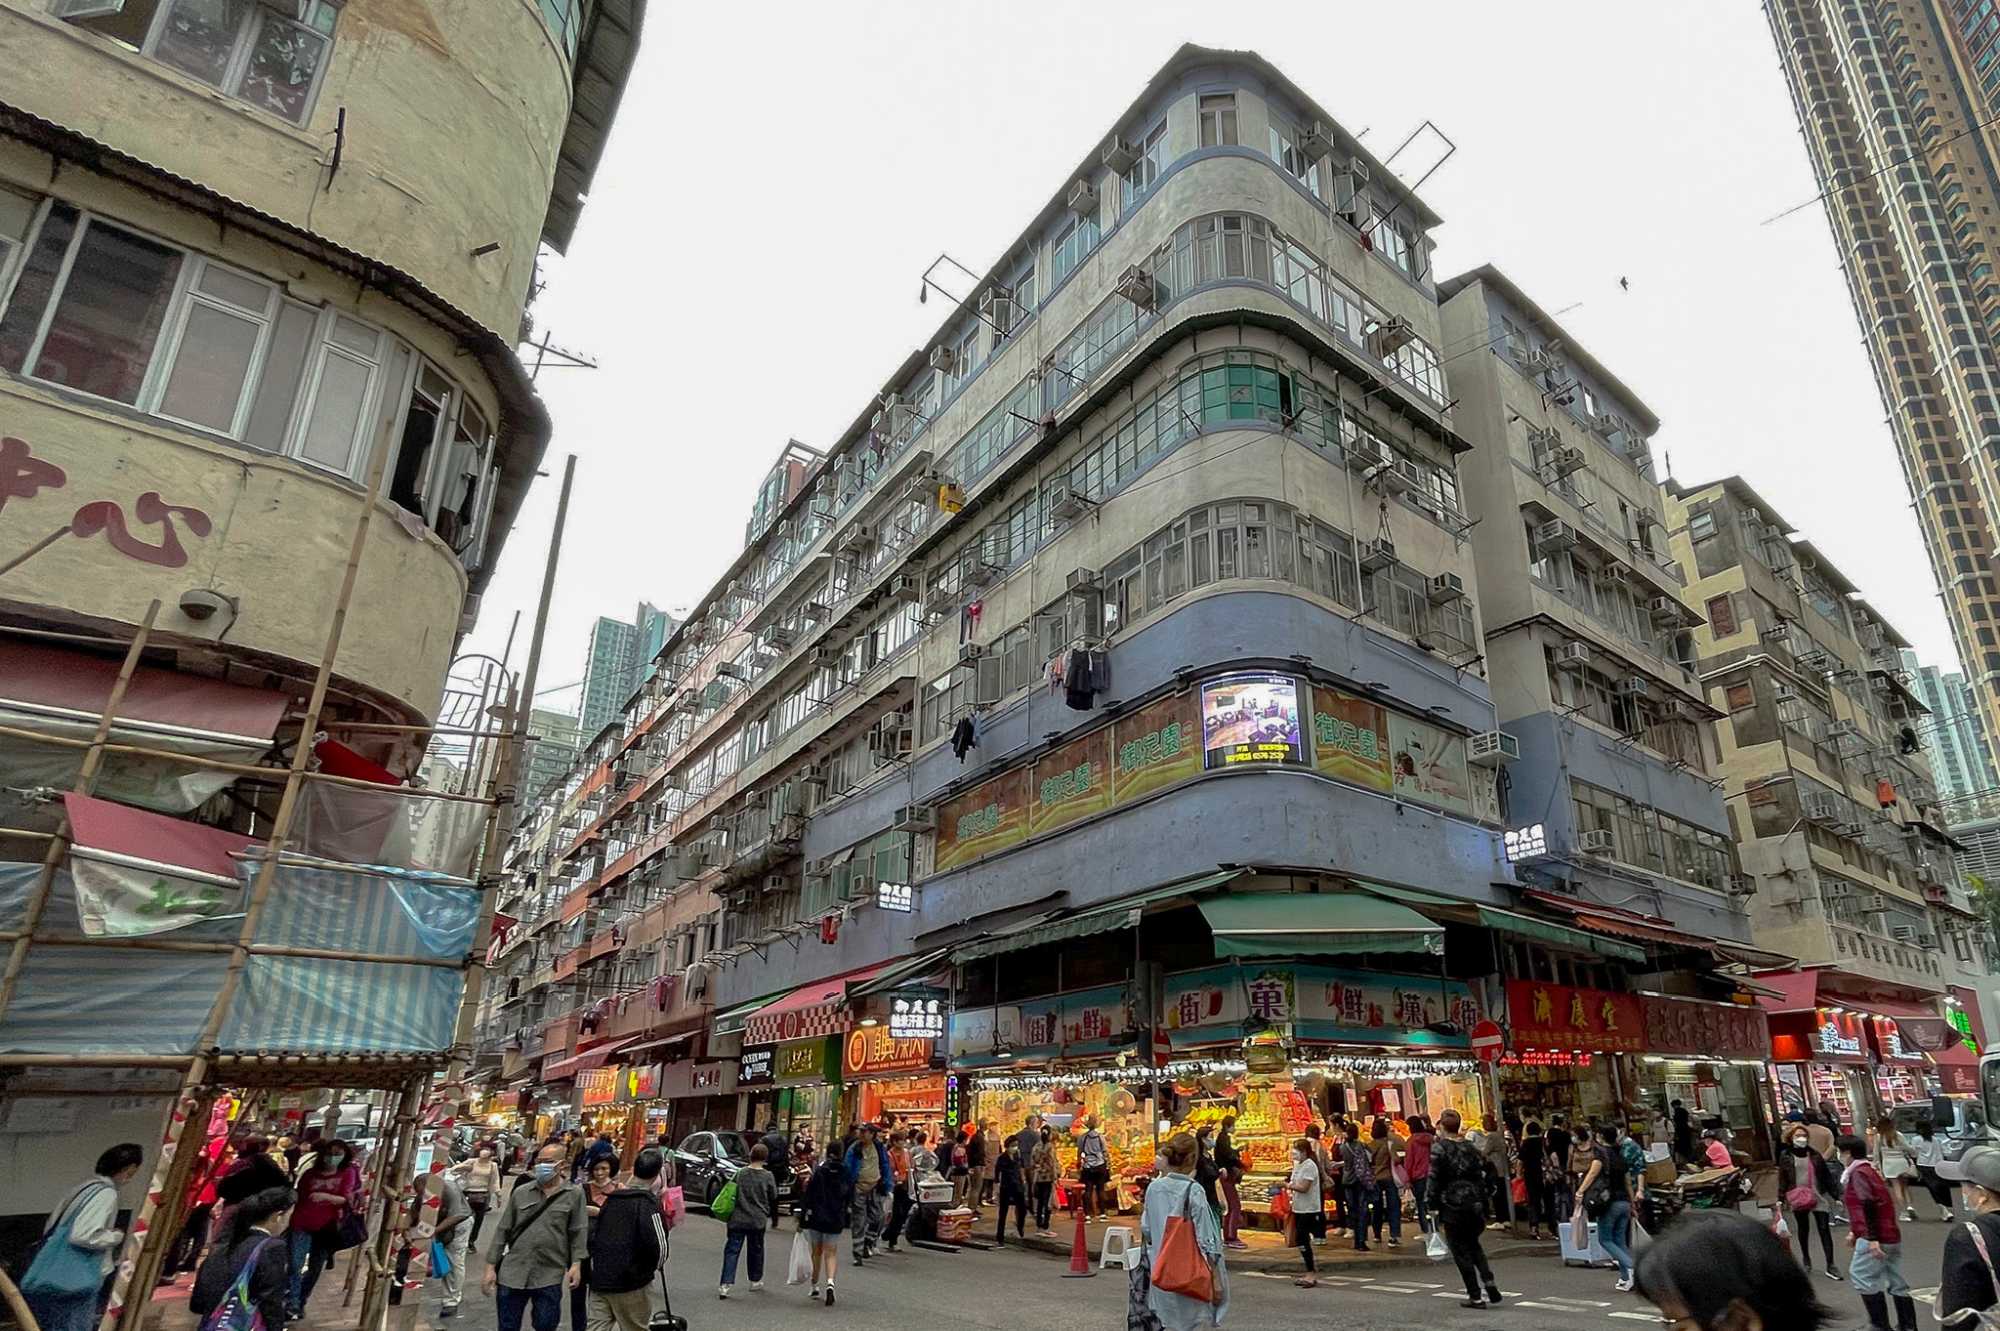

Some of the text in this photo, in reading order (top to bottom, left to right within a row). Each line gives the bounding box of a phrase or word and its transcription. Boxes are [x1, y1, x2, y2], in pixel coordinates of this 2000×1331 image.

[1120, 722, 1182, 776] 御足園
[1315, 712, 1379, 762] 御足園
[1179, 991, 1200, 1026] 街
[1249, 981, 1285, 1018] 菓
